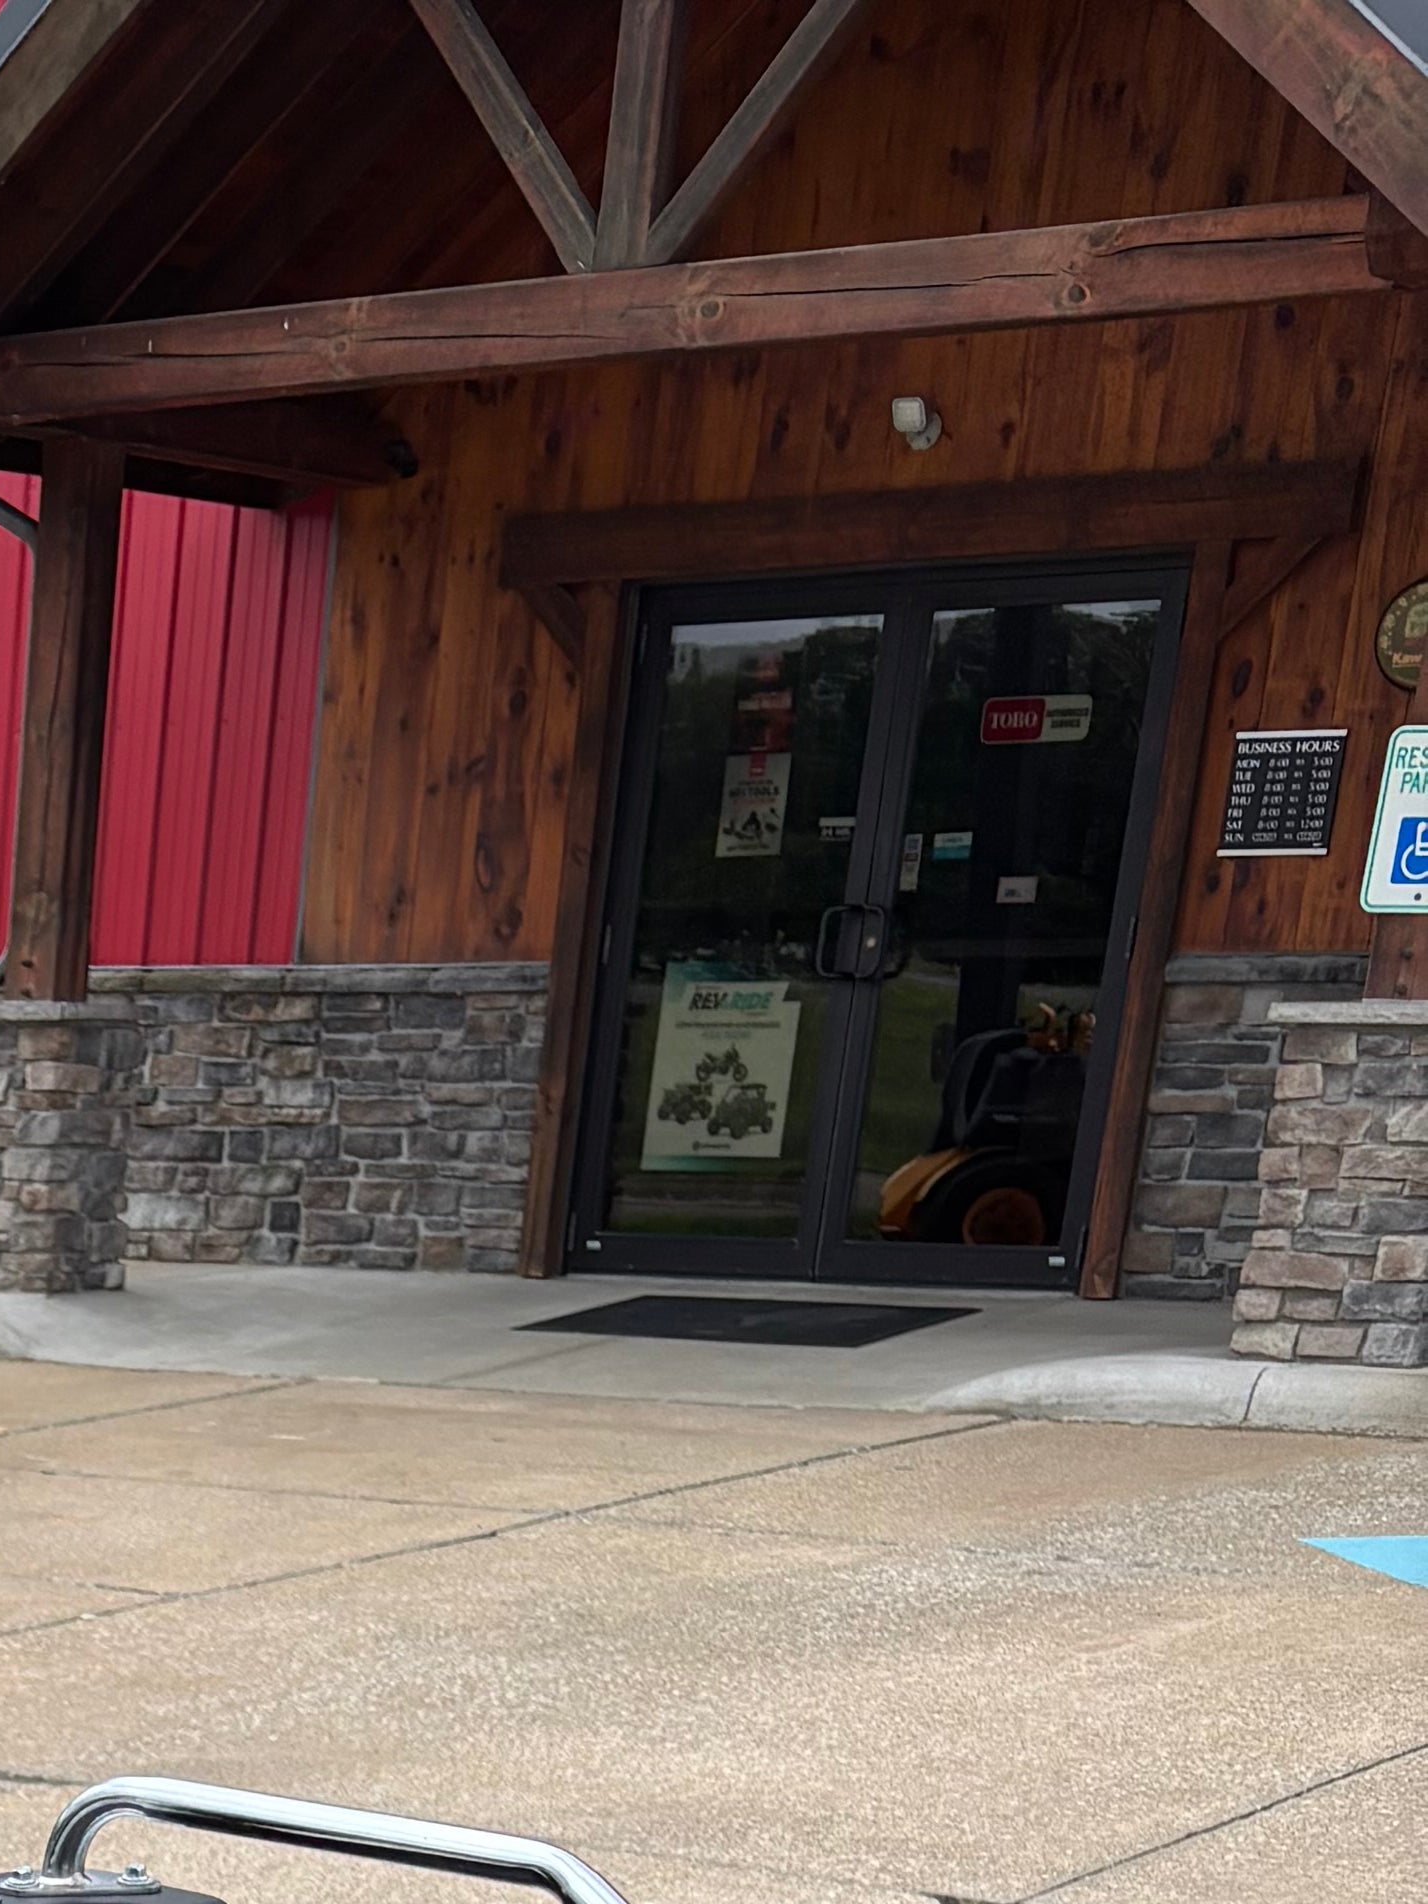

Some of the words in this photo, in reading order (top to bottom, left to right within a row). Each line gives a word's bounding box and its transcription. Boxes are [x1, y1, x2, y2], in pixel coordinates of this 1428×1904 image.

[989, 711, 1038, 729] TORO
[1238, 742, 1292, 754] BUSINESS
[1296, 740, 1340, 752] HOURS
[1236, 759, 1260, 768] MON
[1235, 771, 1252, 780] TUE
[1232, 783, 1256, 793] WED
[1231, 796, 1251, 806] THU
[1227, 808, 1243, 818] FRI
[1226, 820, 1242, 830] SAT
[1224, 833, 1244, 842] SUN
